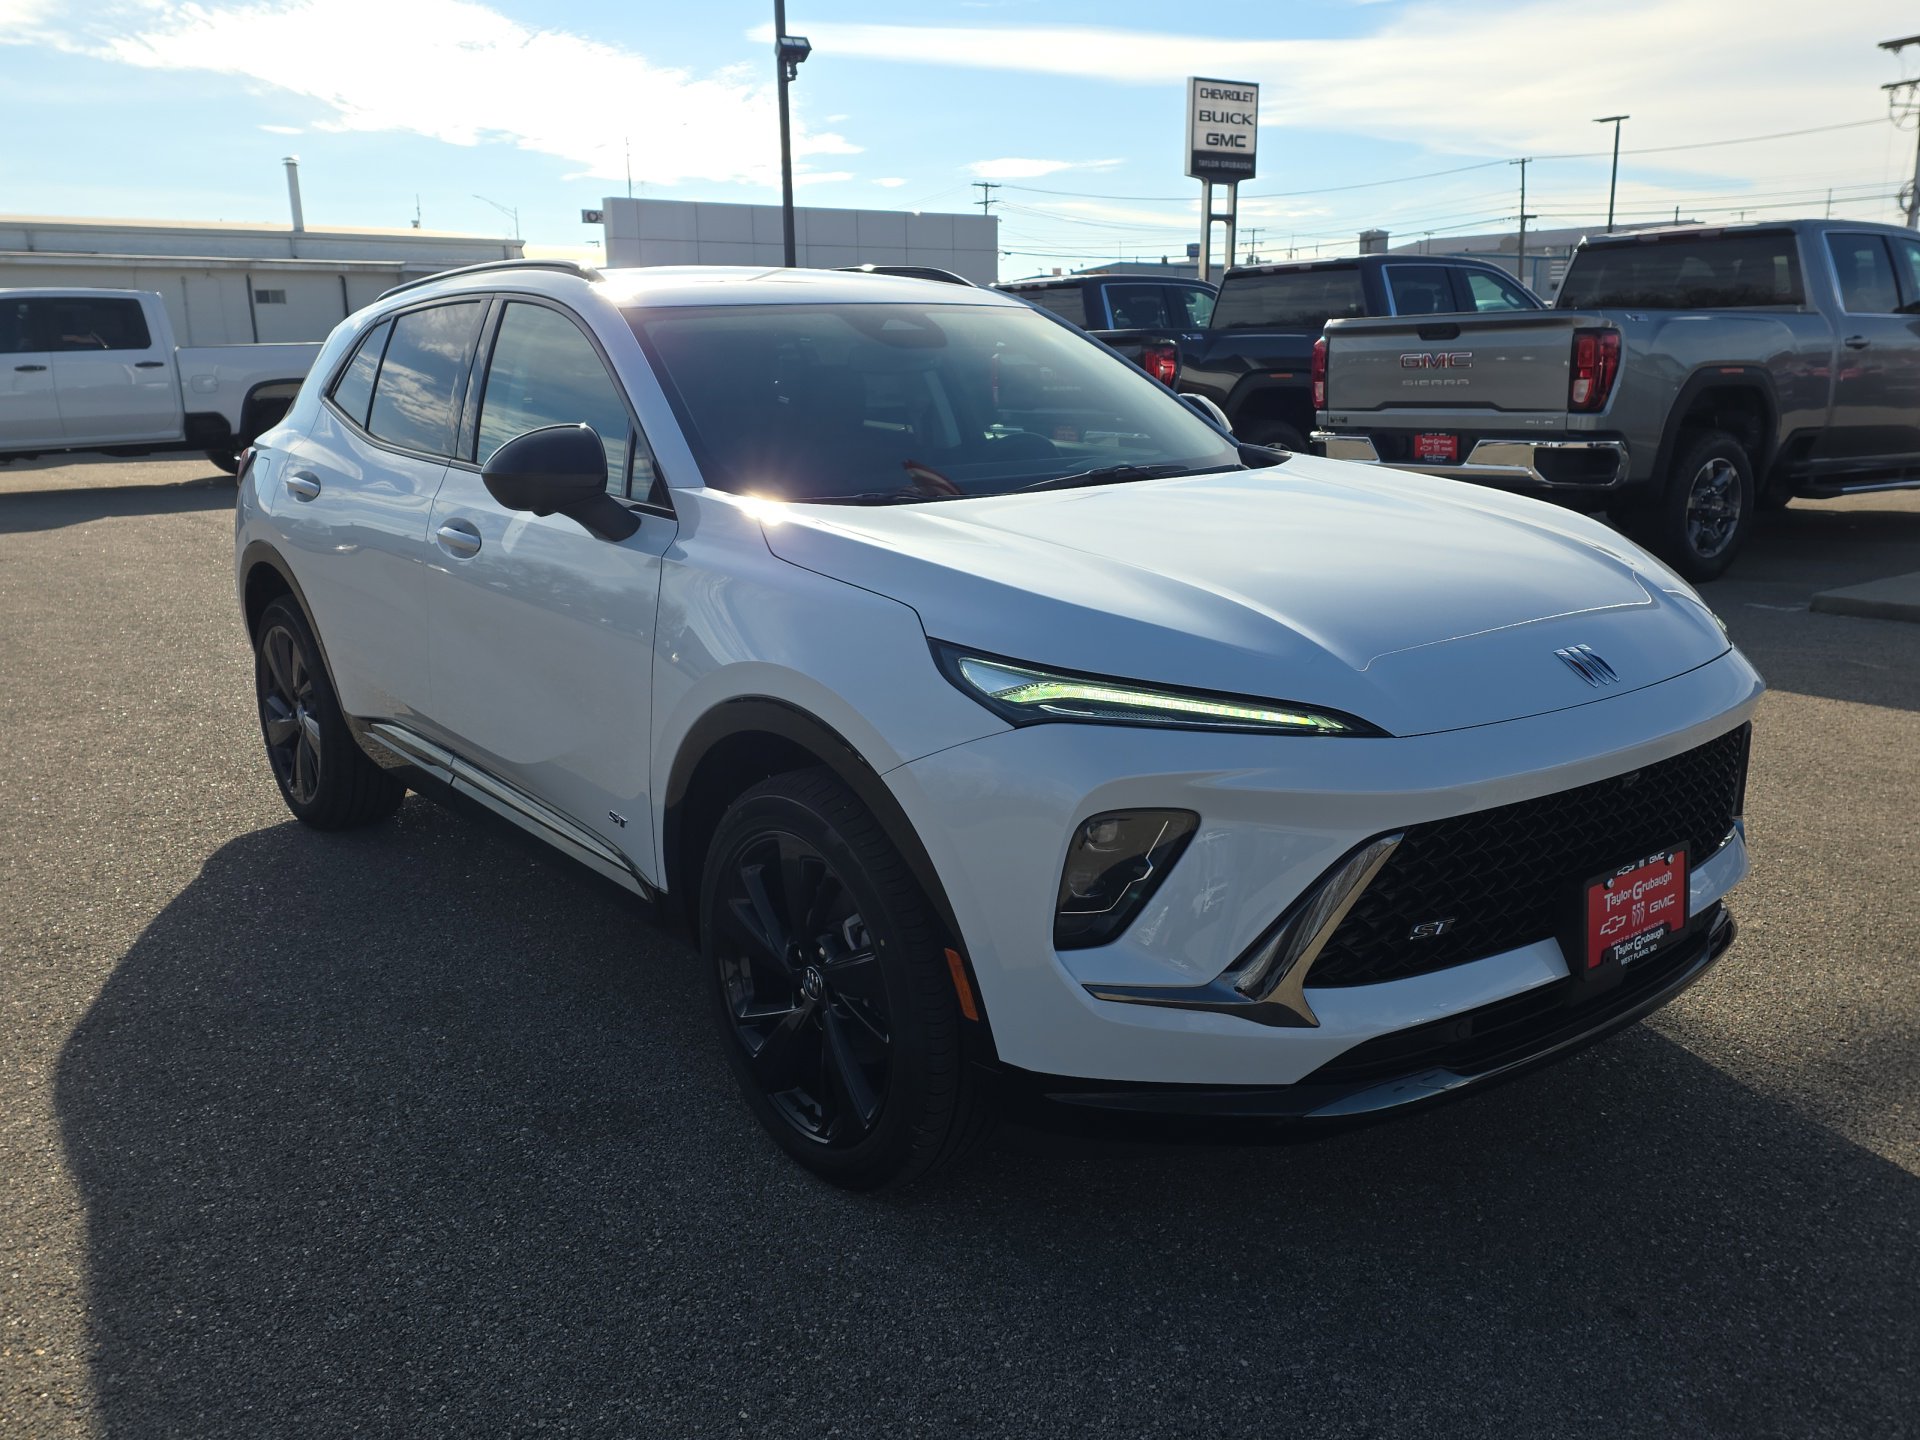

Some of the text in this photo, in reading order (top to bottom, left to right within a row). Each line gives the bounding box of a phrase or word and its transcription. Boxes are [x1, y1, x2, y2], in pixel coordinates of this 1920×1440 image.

[1200, 88, 1254, 102] CHEVROLET
[1199, 110, 1254, 126] BUICK
[1206, 133, 1247, 148] GMC
[1400, 352, 1473, 369] GMC
[608, 809, 628, 829] ST
[1649, 852, 1665, 864] GMC
[1604, 870, 1672, 912] Taylor Grubaugh
[1649, 894, 1675, 914] GMC
[1410, 918, 1456, 940] ST
[1613, 927, 1664, 960] Taylor Grubaugh
[1620, 954, 1633, 966] WEST
